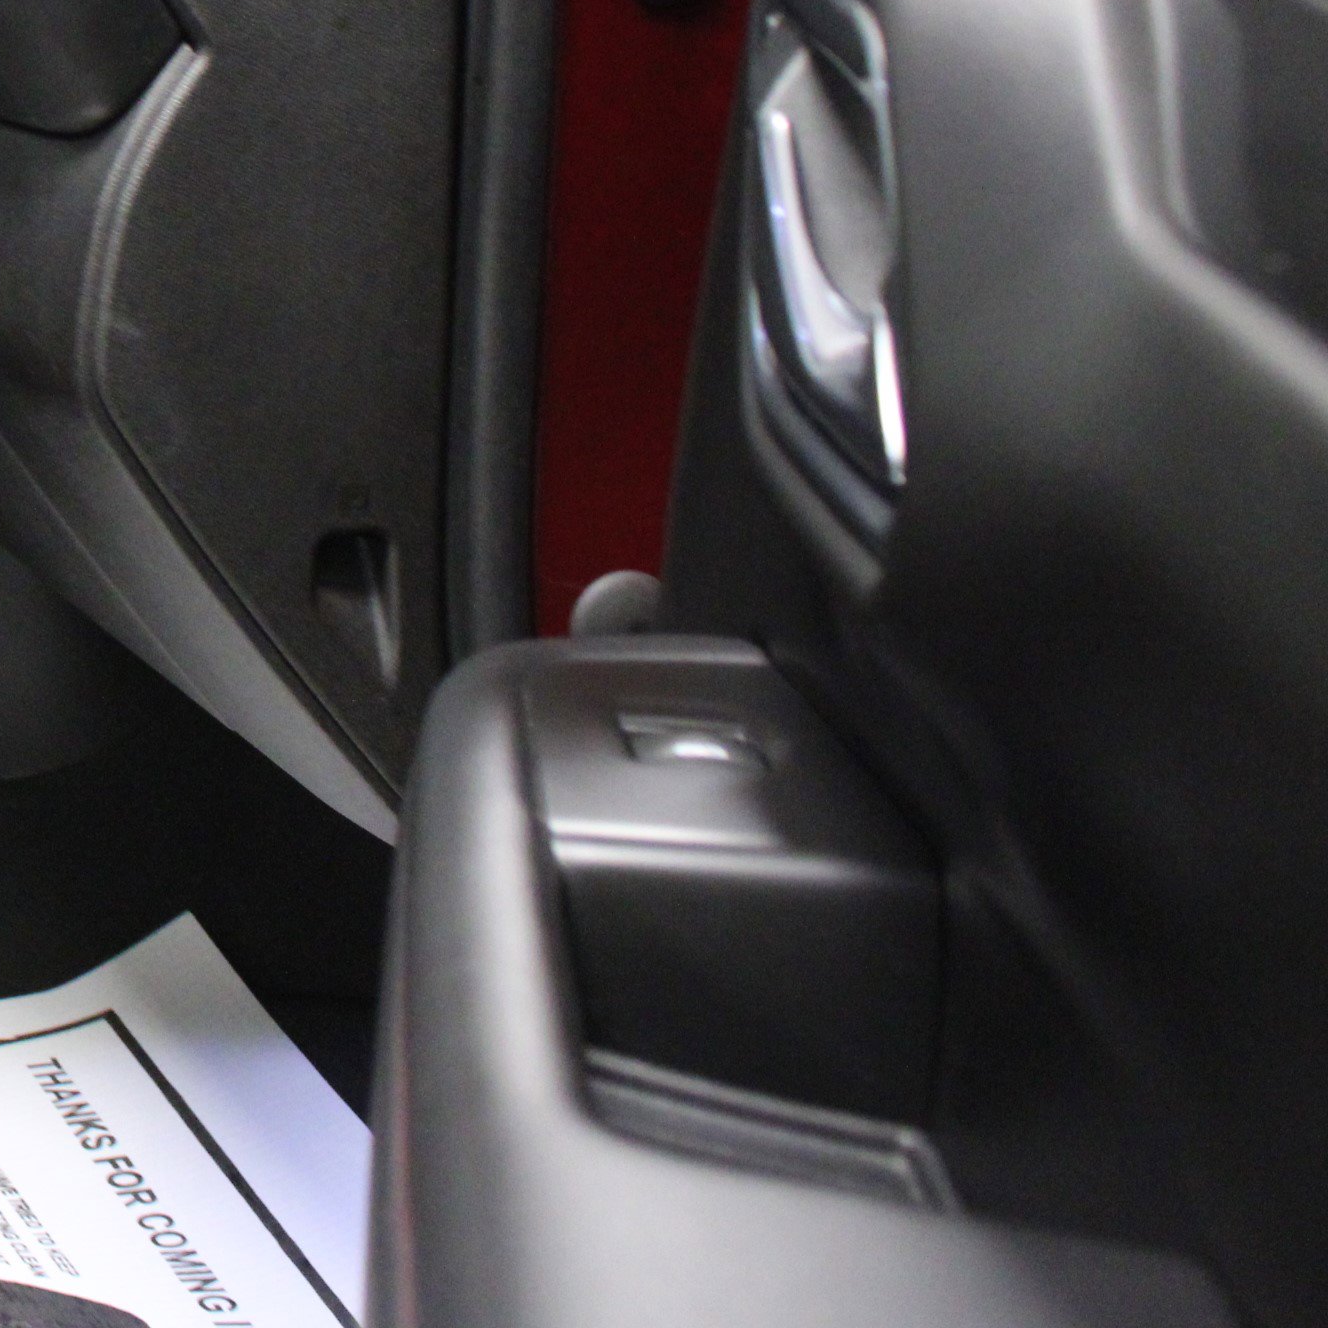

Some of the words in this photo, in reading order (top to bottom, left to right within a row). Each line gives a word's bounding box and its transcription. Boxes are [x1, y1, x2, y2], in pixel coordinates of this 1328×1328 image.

[27, 1056, 116, 1151] THANKS
[93, 1154, 158, 1207] FOR
[137, 1213, 237, 1314] COMING
[11, 1242, 48, 1277] CLEAN
